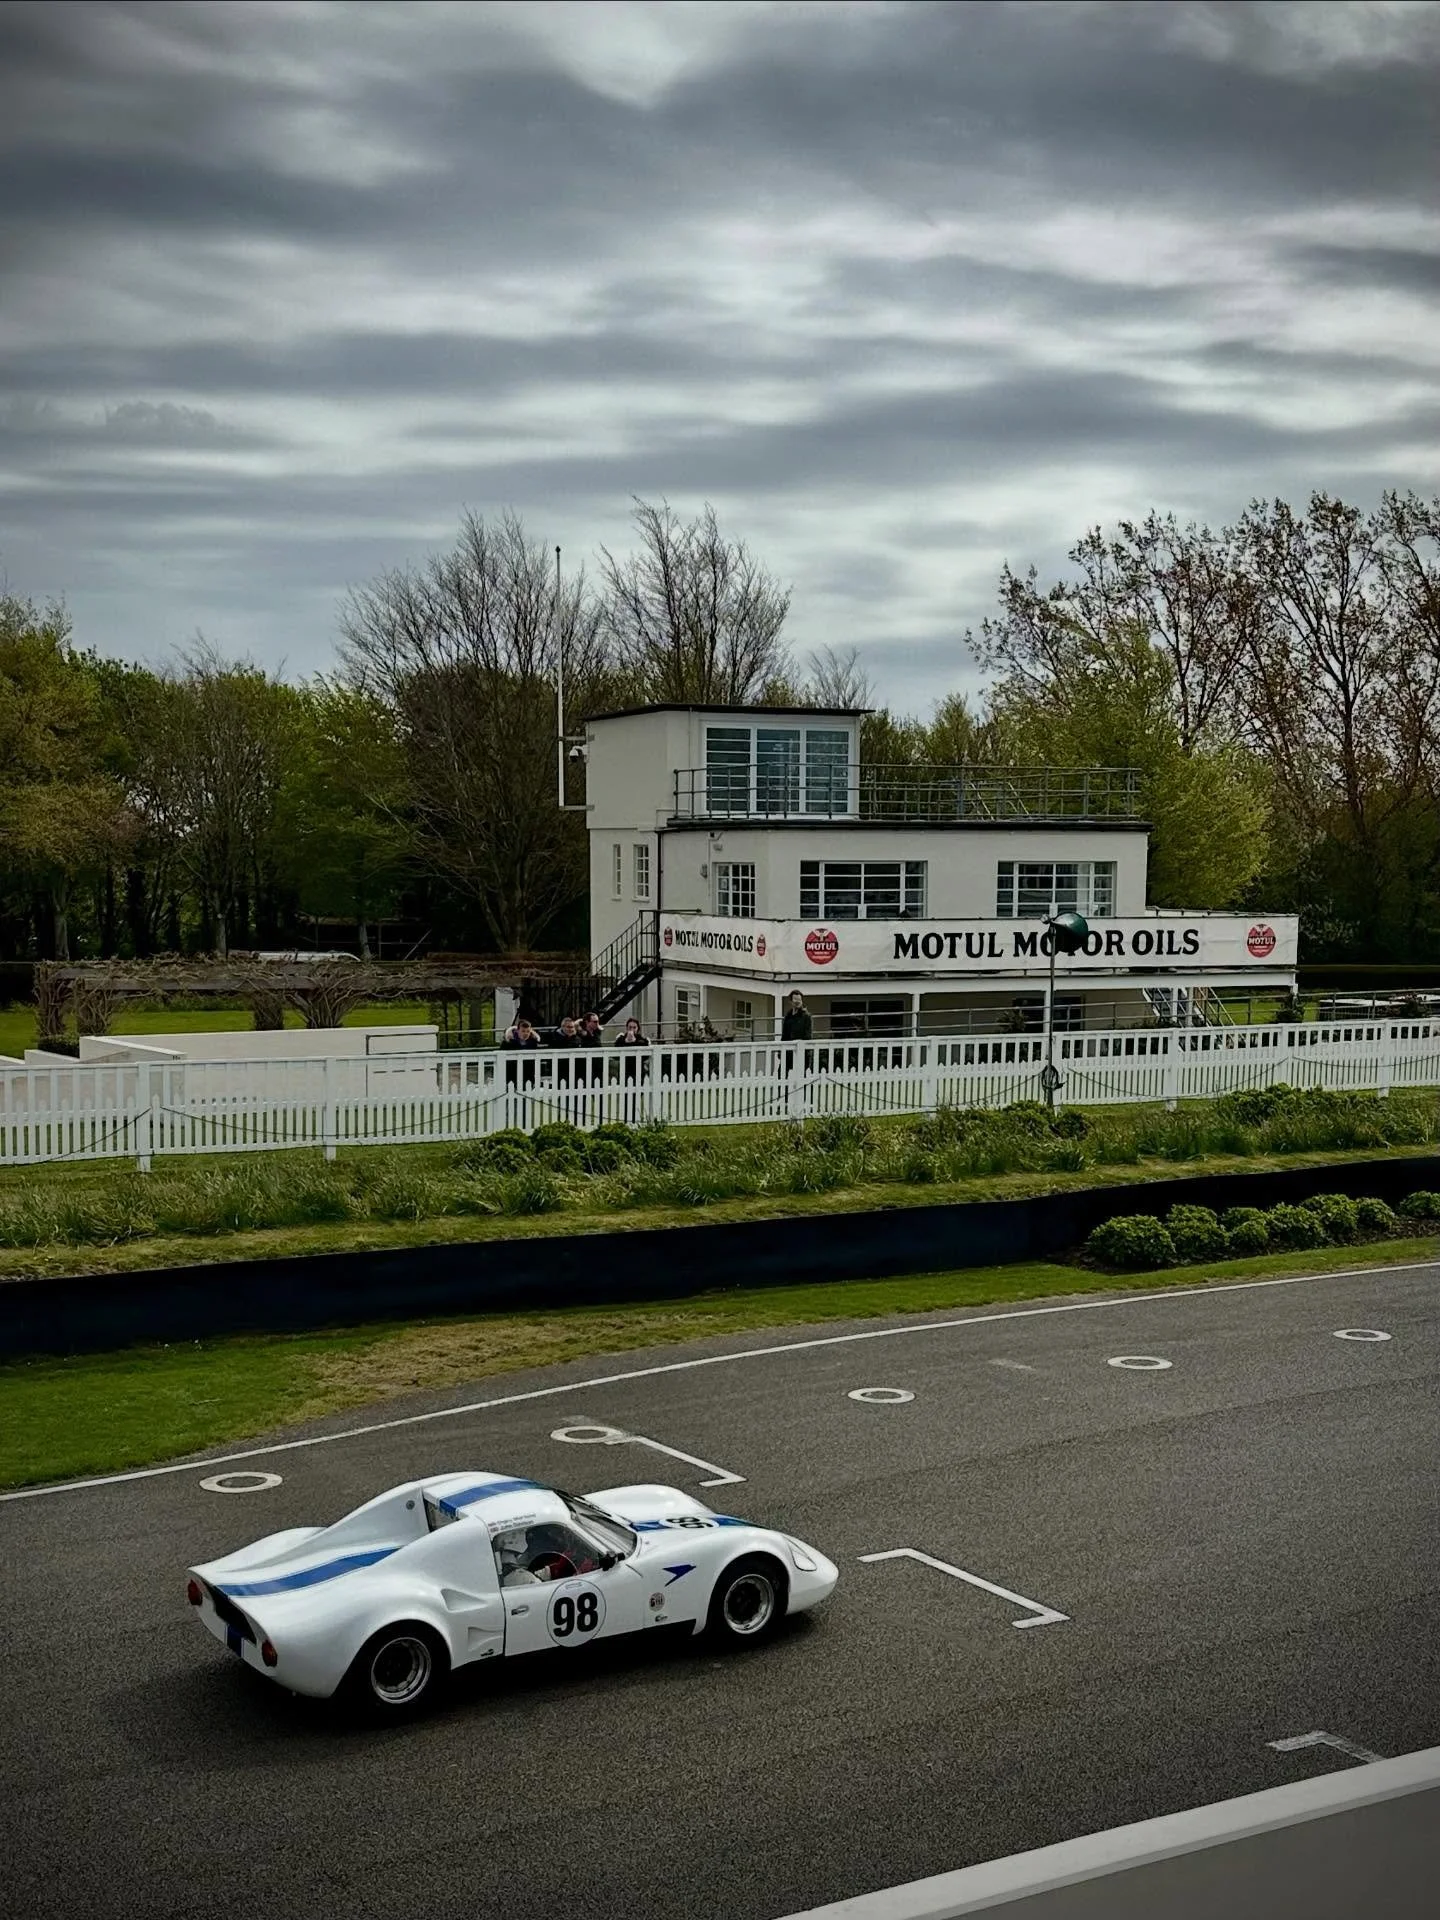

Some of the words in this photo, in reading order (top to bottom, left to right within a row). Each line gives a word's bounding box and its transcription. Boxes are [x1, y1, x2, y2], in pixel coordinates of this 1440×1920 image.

[675, 930, 699, 947] MOTUL
[700, 932, 732, 950] MOTOR
[733, 935, 753, 952] OILS
[806, 942, 837, 950] MOTUL
[894, 932, 1004, 959] MOTUL
[1132, 929, 1200, 955] OILS
[1248, 937, 1275, 945] MOTUL
[553, 1592, 598, 1637] 98
